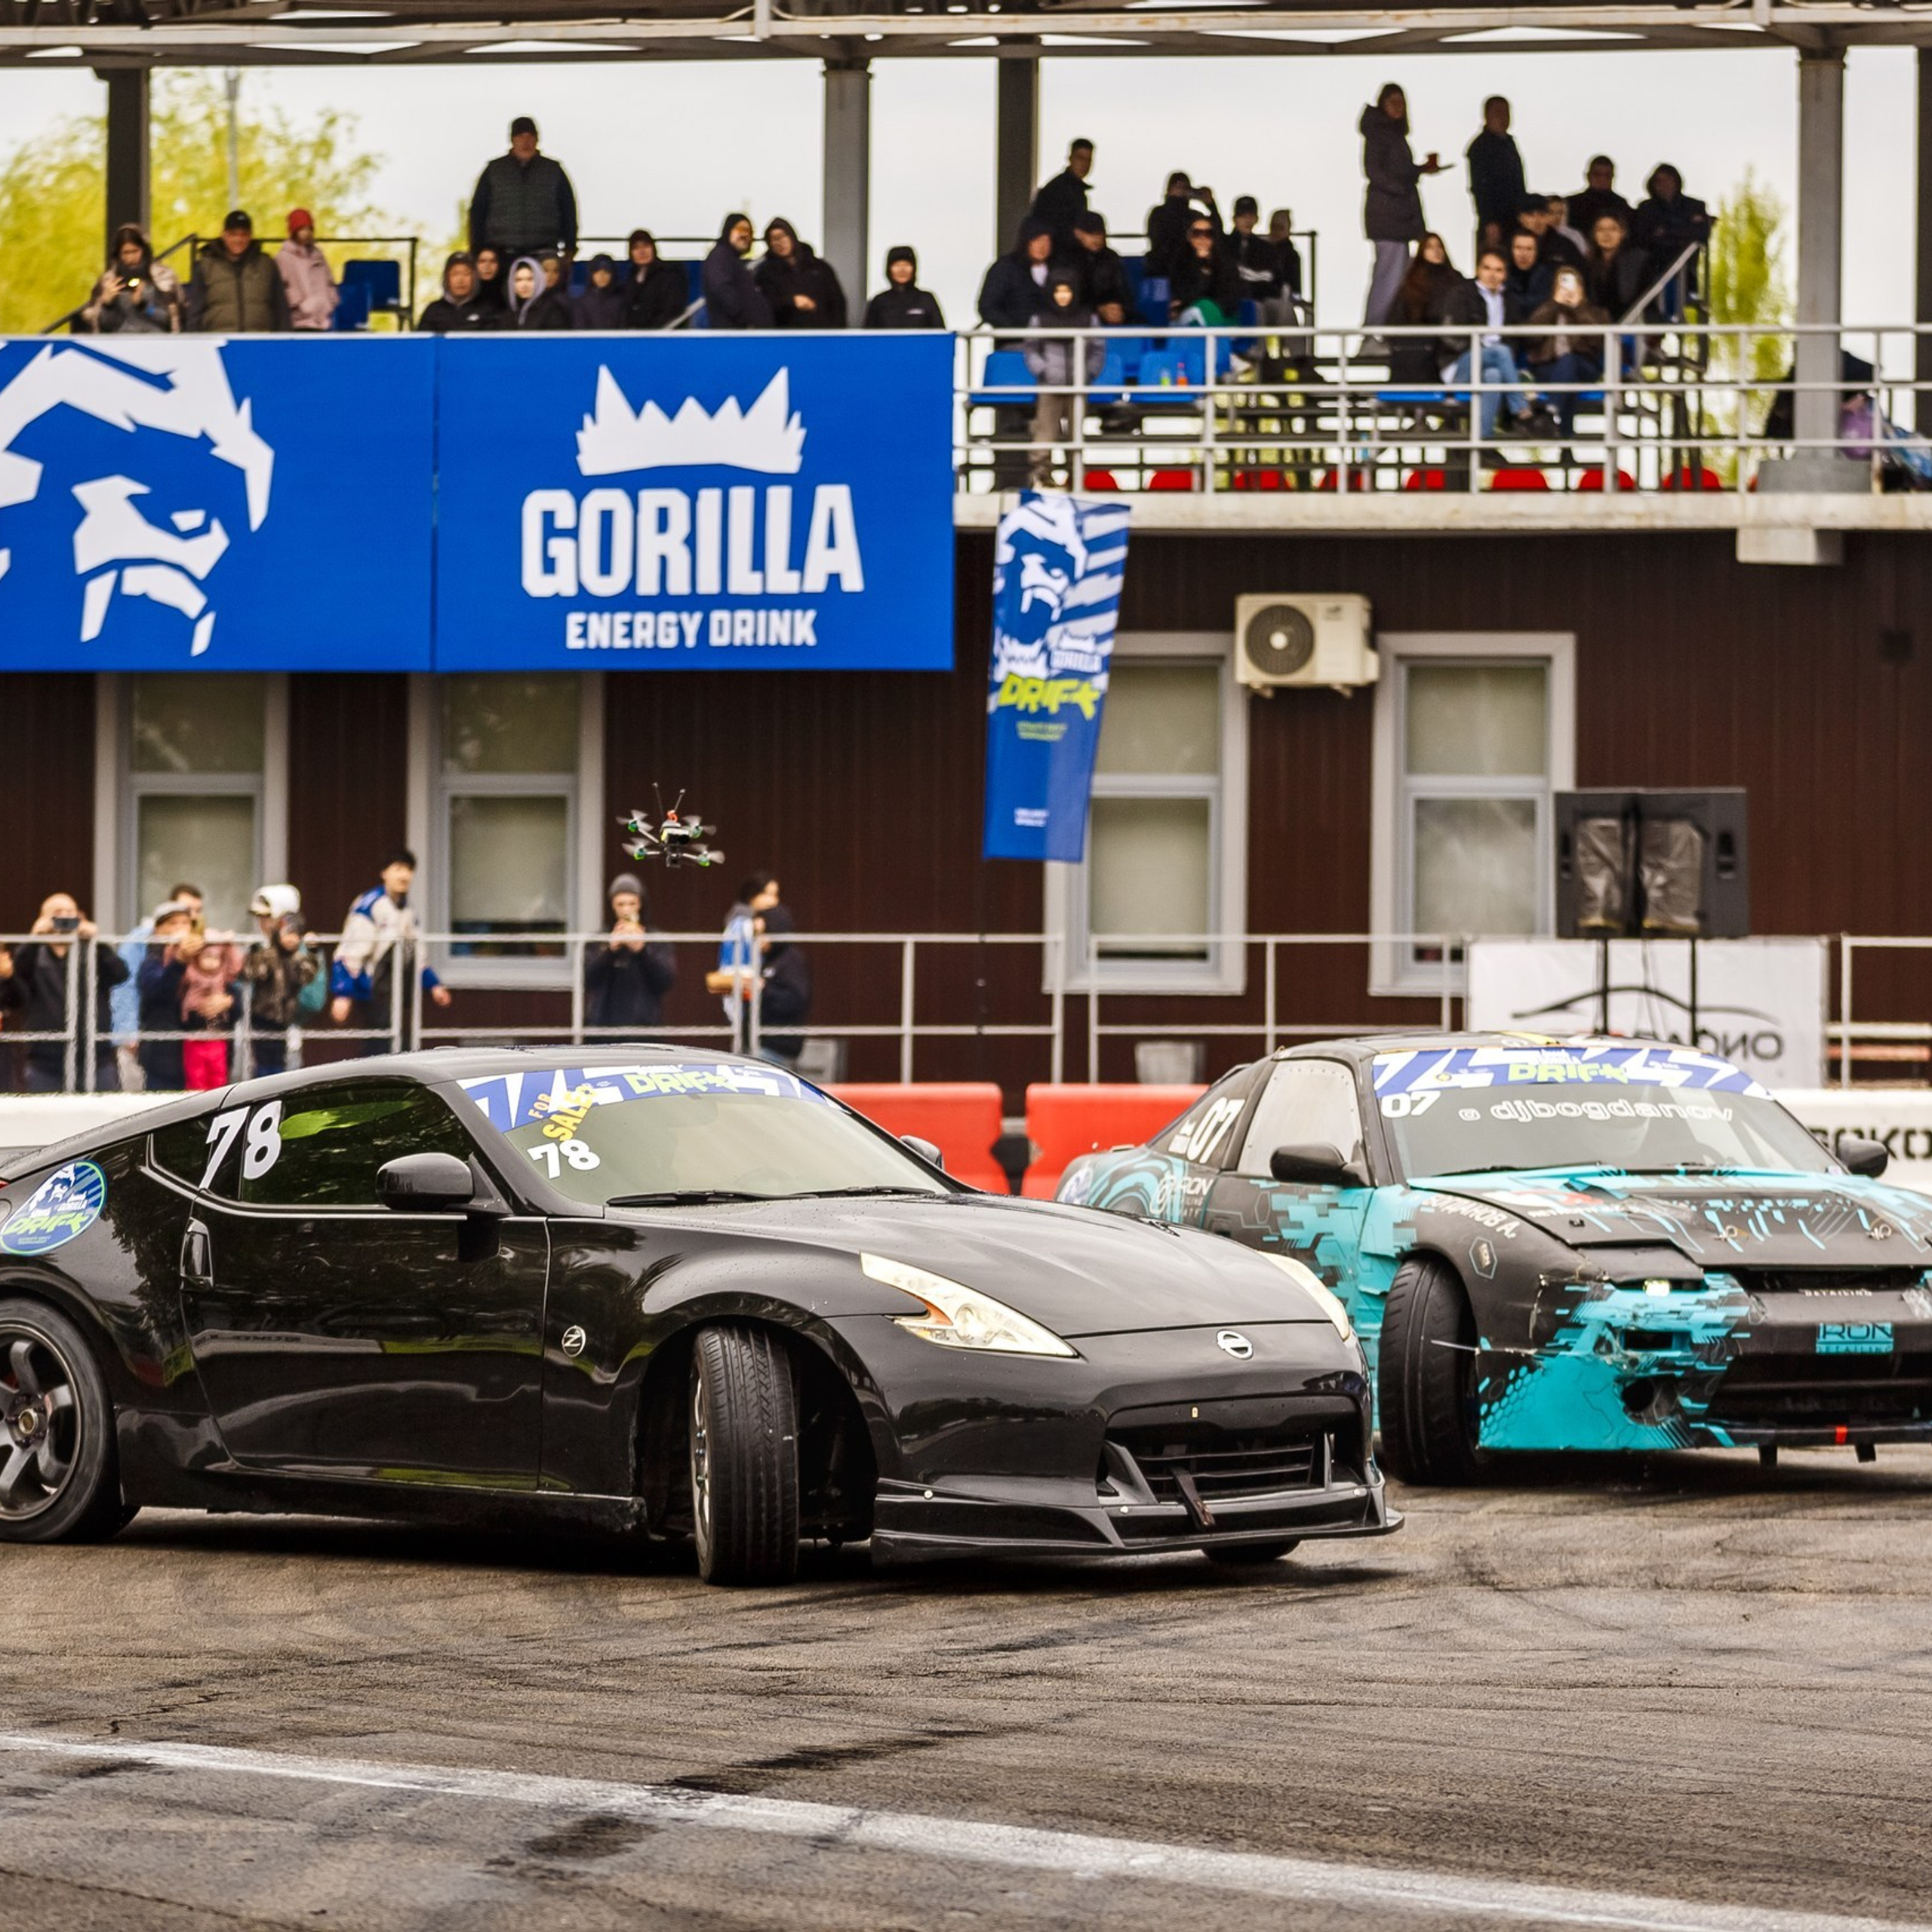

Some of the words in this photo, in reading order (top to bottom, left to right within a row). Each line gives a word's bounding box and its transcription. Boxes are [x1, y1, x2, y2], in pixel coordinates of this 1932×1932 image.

[521, 484, 864, 598] GORILLA
[566, 611, 703, 650] ENERGY
[709, 609, 817, 647] DRINK
[528, 1093, 552, 1119] FOR
[543, 1091, 593, 1142] SALE
[1381, 1091, 1441, 1118] 07
[1490, 1099, 1733, 1122] djbogdanov
[198, 1100, 282, 1189] 78
[1186, 1097, 1245, 1164] 07
[527, 1139, 601, 1179] 78
